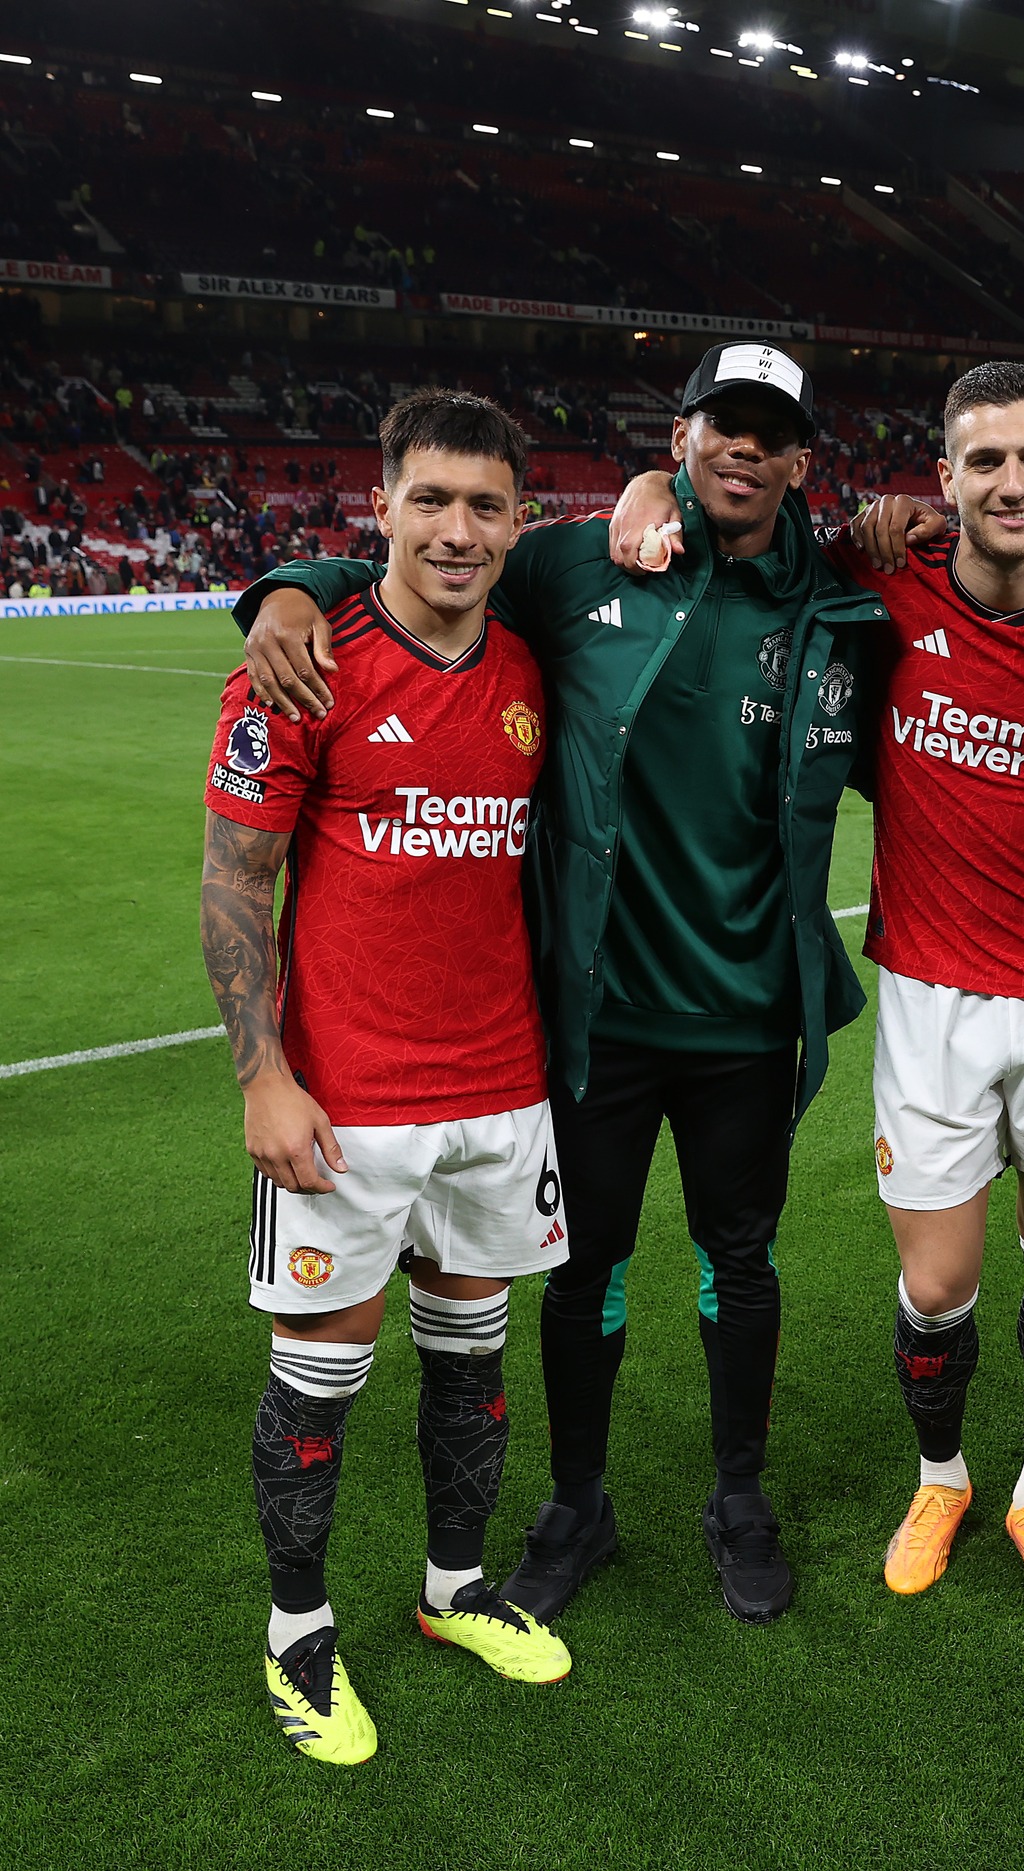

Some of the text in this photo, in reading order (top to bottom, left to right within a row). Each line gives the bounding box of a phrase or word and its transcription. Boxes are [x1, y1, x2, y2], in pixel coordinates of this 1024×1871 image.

[27, 264, 102, 284] DREAM
[198, 276, 381, 305] SIR ALEX 26 YEARS
[447, 295, 494, 313] MADE
[762, 348, 773, 356] IV
[759, 359, 772, 369] VII
[758, 372, 769, 380] IV
[4, 598, 237, 618] DVANCING CLEANE
[821, 666, 852, 685] MANCHESTER
[505, 703, 538, 724] MANCHESTER
[760, 704, 782, 725] Tez
[822, 727, 853, 744] Tezos
[517, 743, 537, 752] UNITED
[213, 763, 260, 793] No room
[211, 776, 264, 804] for racism
[395, 787, 508, 825] Team
[358, 812, 505, 858] Viewer
[535, 1143, 561, 1217] 6
[298, 1277, 324, 1285] UNITED
